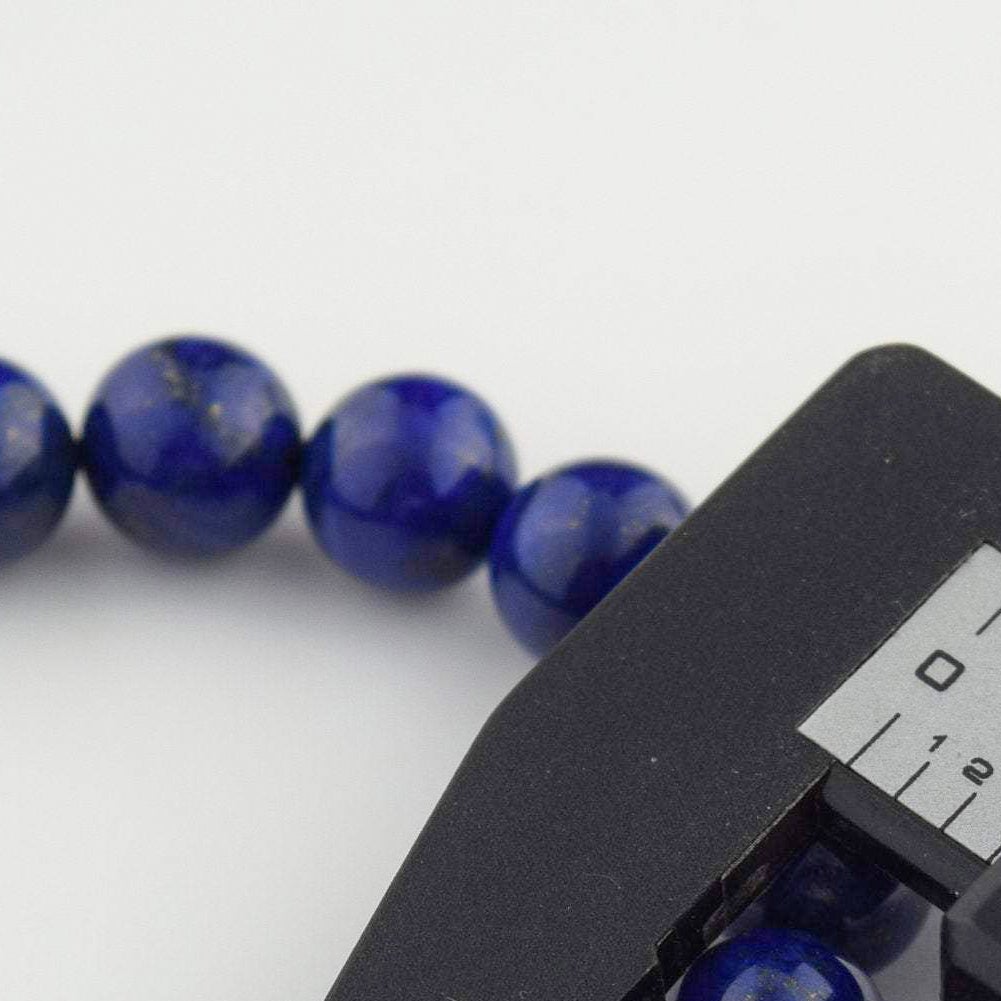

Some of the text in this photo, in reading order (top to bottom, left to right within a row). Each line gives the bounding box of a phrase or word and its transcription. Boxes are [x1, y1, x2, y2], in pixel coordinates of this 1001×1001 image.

[915, 649, 965, 692] 0
[929, 734, 948, 752] 1
[962, 757, 994, 786] 2
